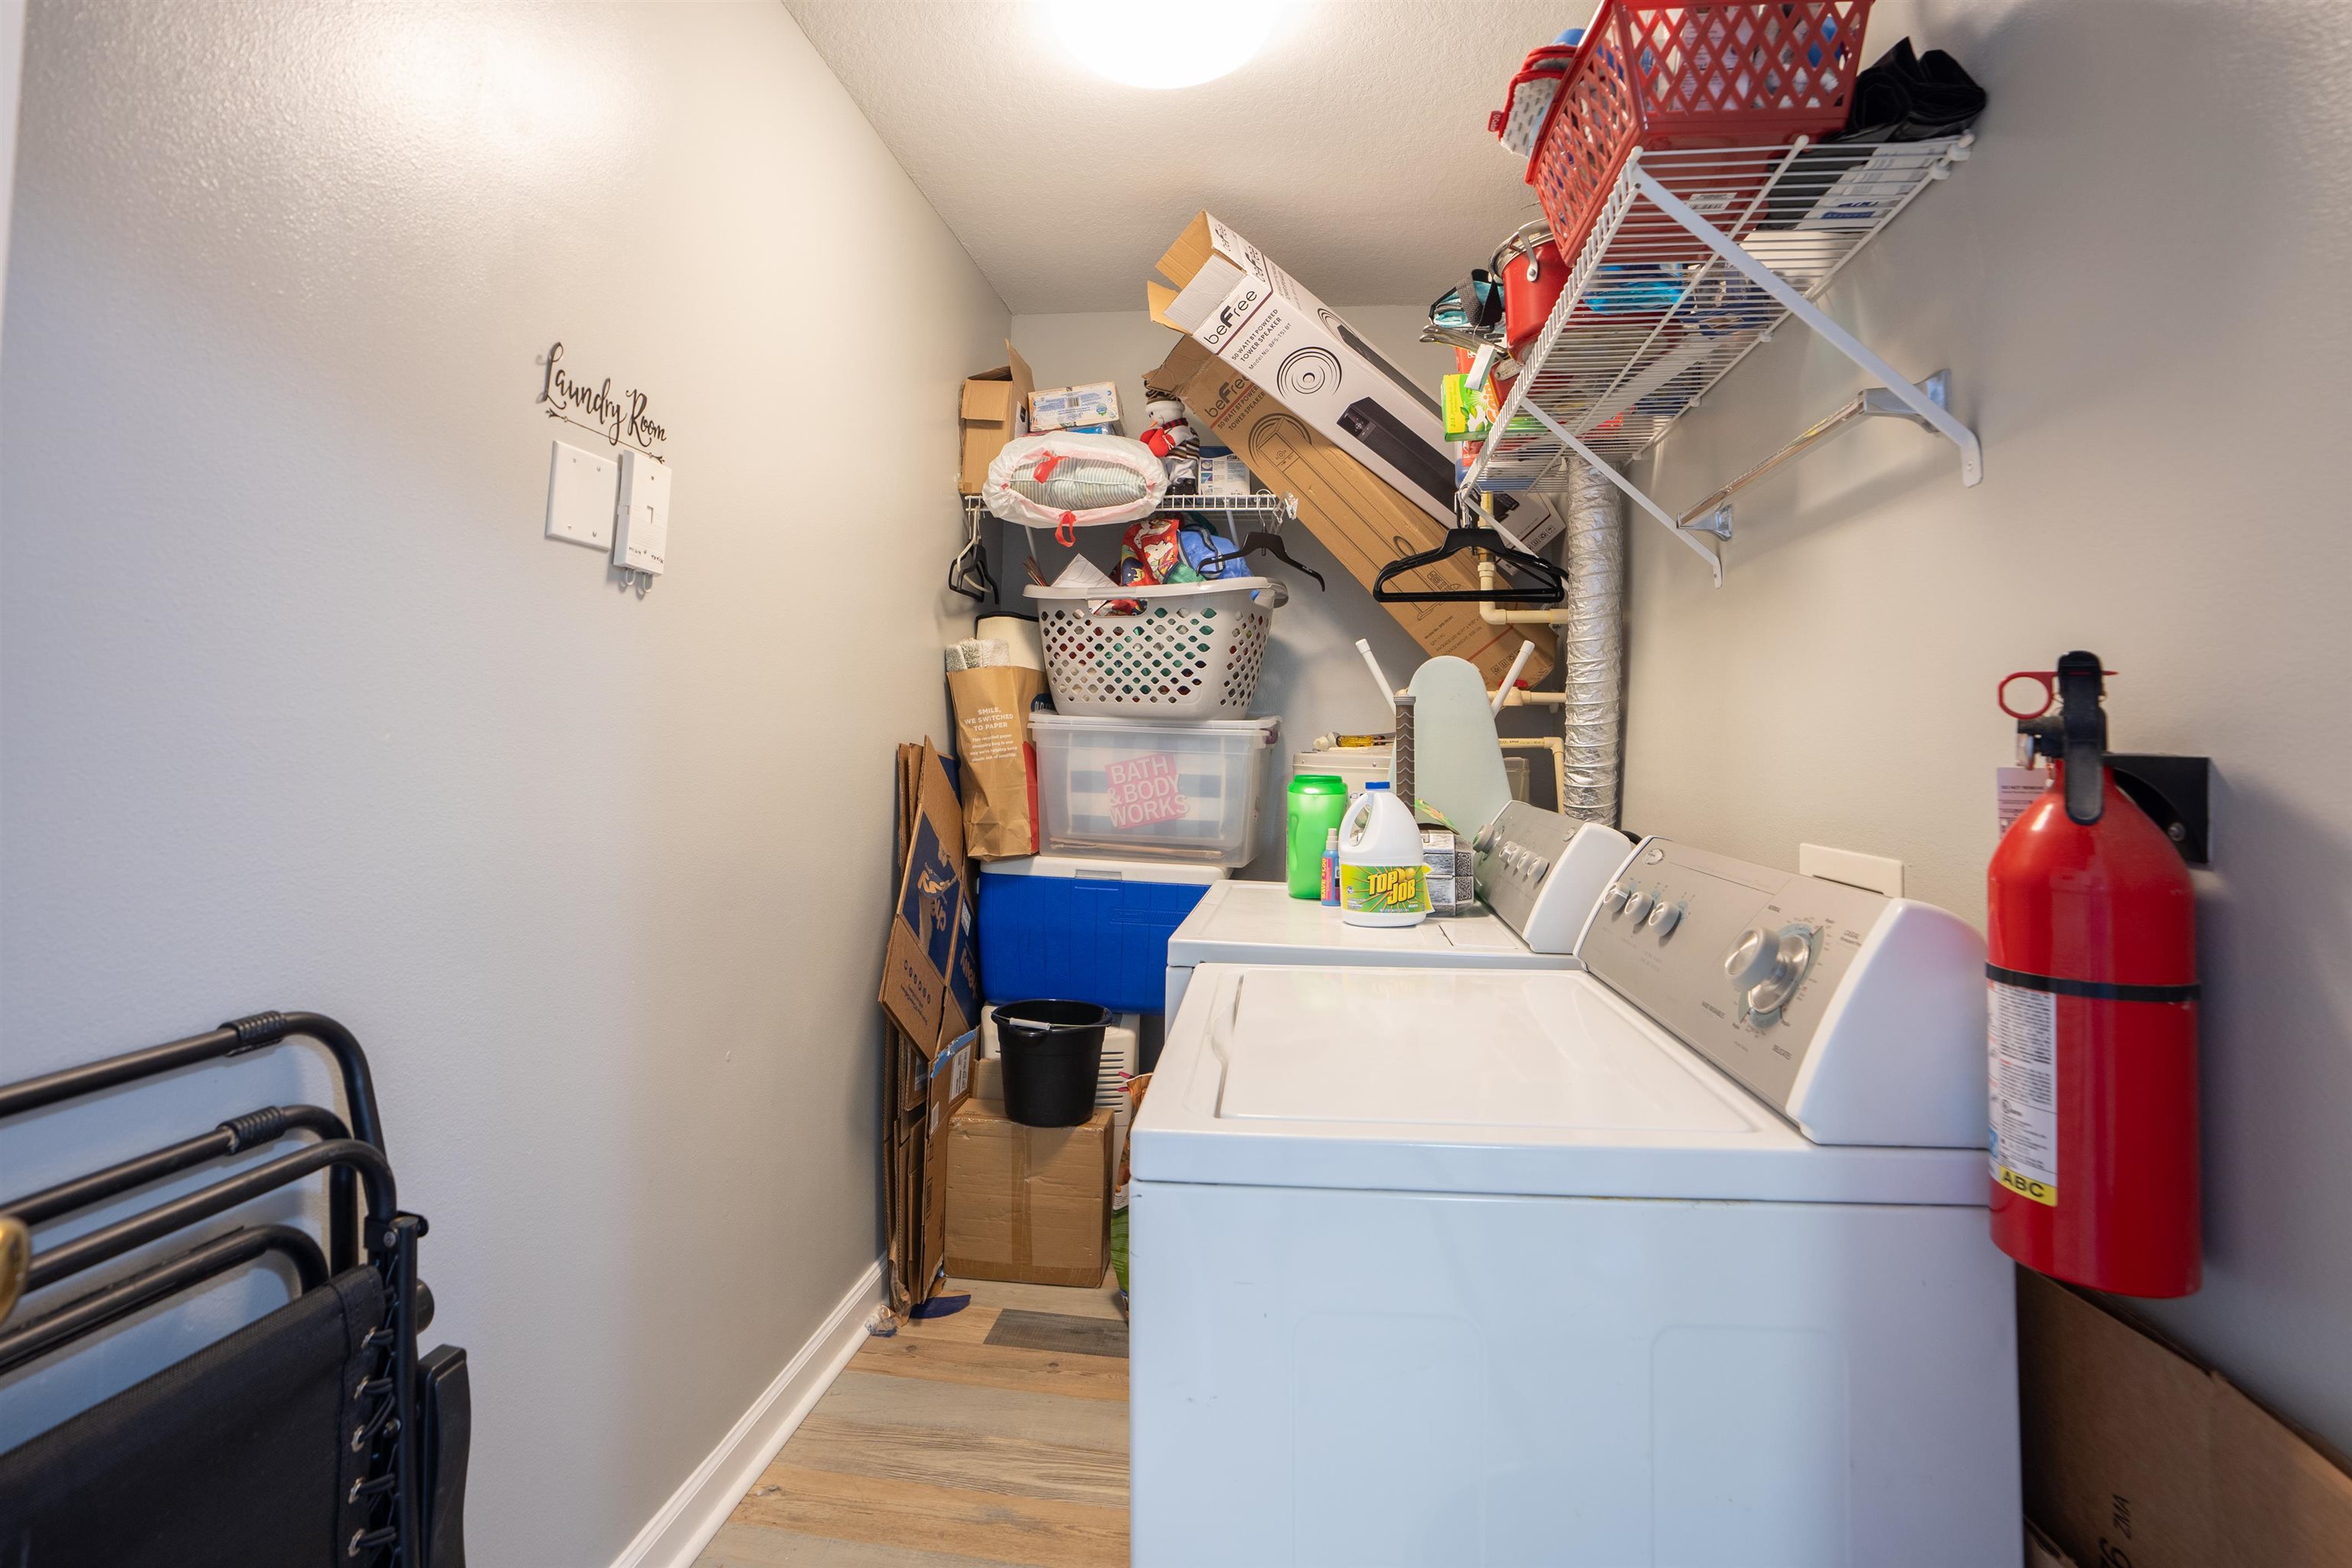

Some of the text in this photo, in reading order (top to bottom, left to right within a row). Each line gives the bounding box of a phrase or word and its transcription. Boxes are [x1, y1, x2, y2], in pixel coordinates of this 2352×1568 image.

[1204, 290, 1257, 345] beFree
[1237, 339, 1251, 354] WATT
[1250, 333, 1256, 341] BT
[1255, 309, 1279, 335] POWERED
[1240, 341, 1260, 362] TOWER
[1258, 317, 1282, 343] SPEAKER
[1248, 354, 1263, 371] Model
[543, 341, 667, 448] Laundry Room
[1224, 410, 1237, 423] WATT
[1228, 391, 1266, 431] TOWER SPEAKER
[978, 707, 1001, 715] SMILE,
[978, 714, 1014, 723] SWITCHED
[1111, 755, 1169, 785] BATH
[1107, 773, 1180, 807] & BODY
[1108, 794, 1189, 828] WORKS
[1367, 871, 1398, 896] TOP
[1387, 878, 1416, 906] JOB
[2003, 1171, 2045, 1197] ABC
